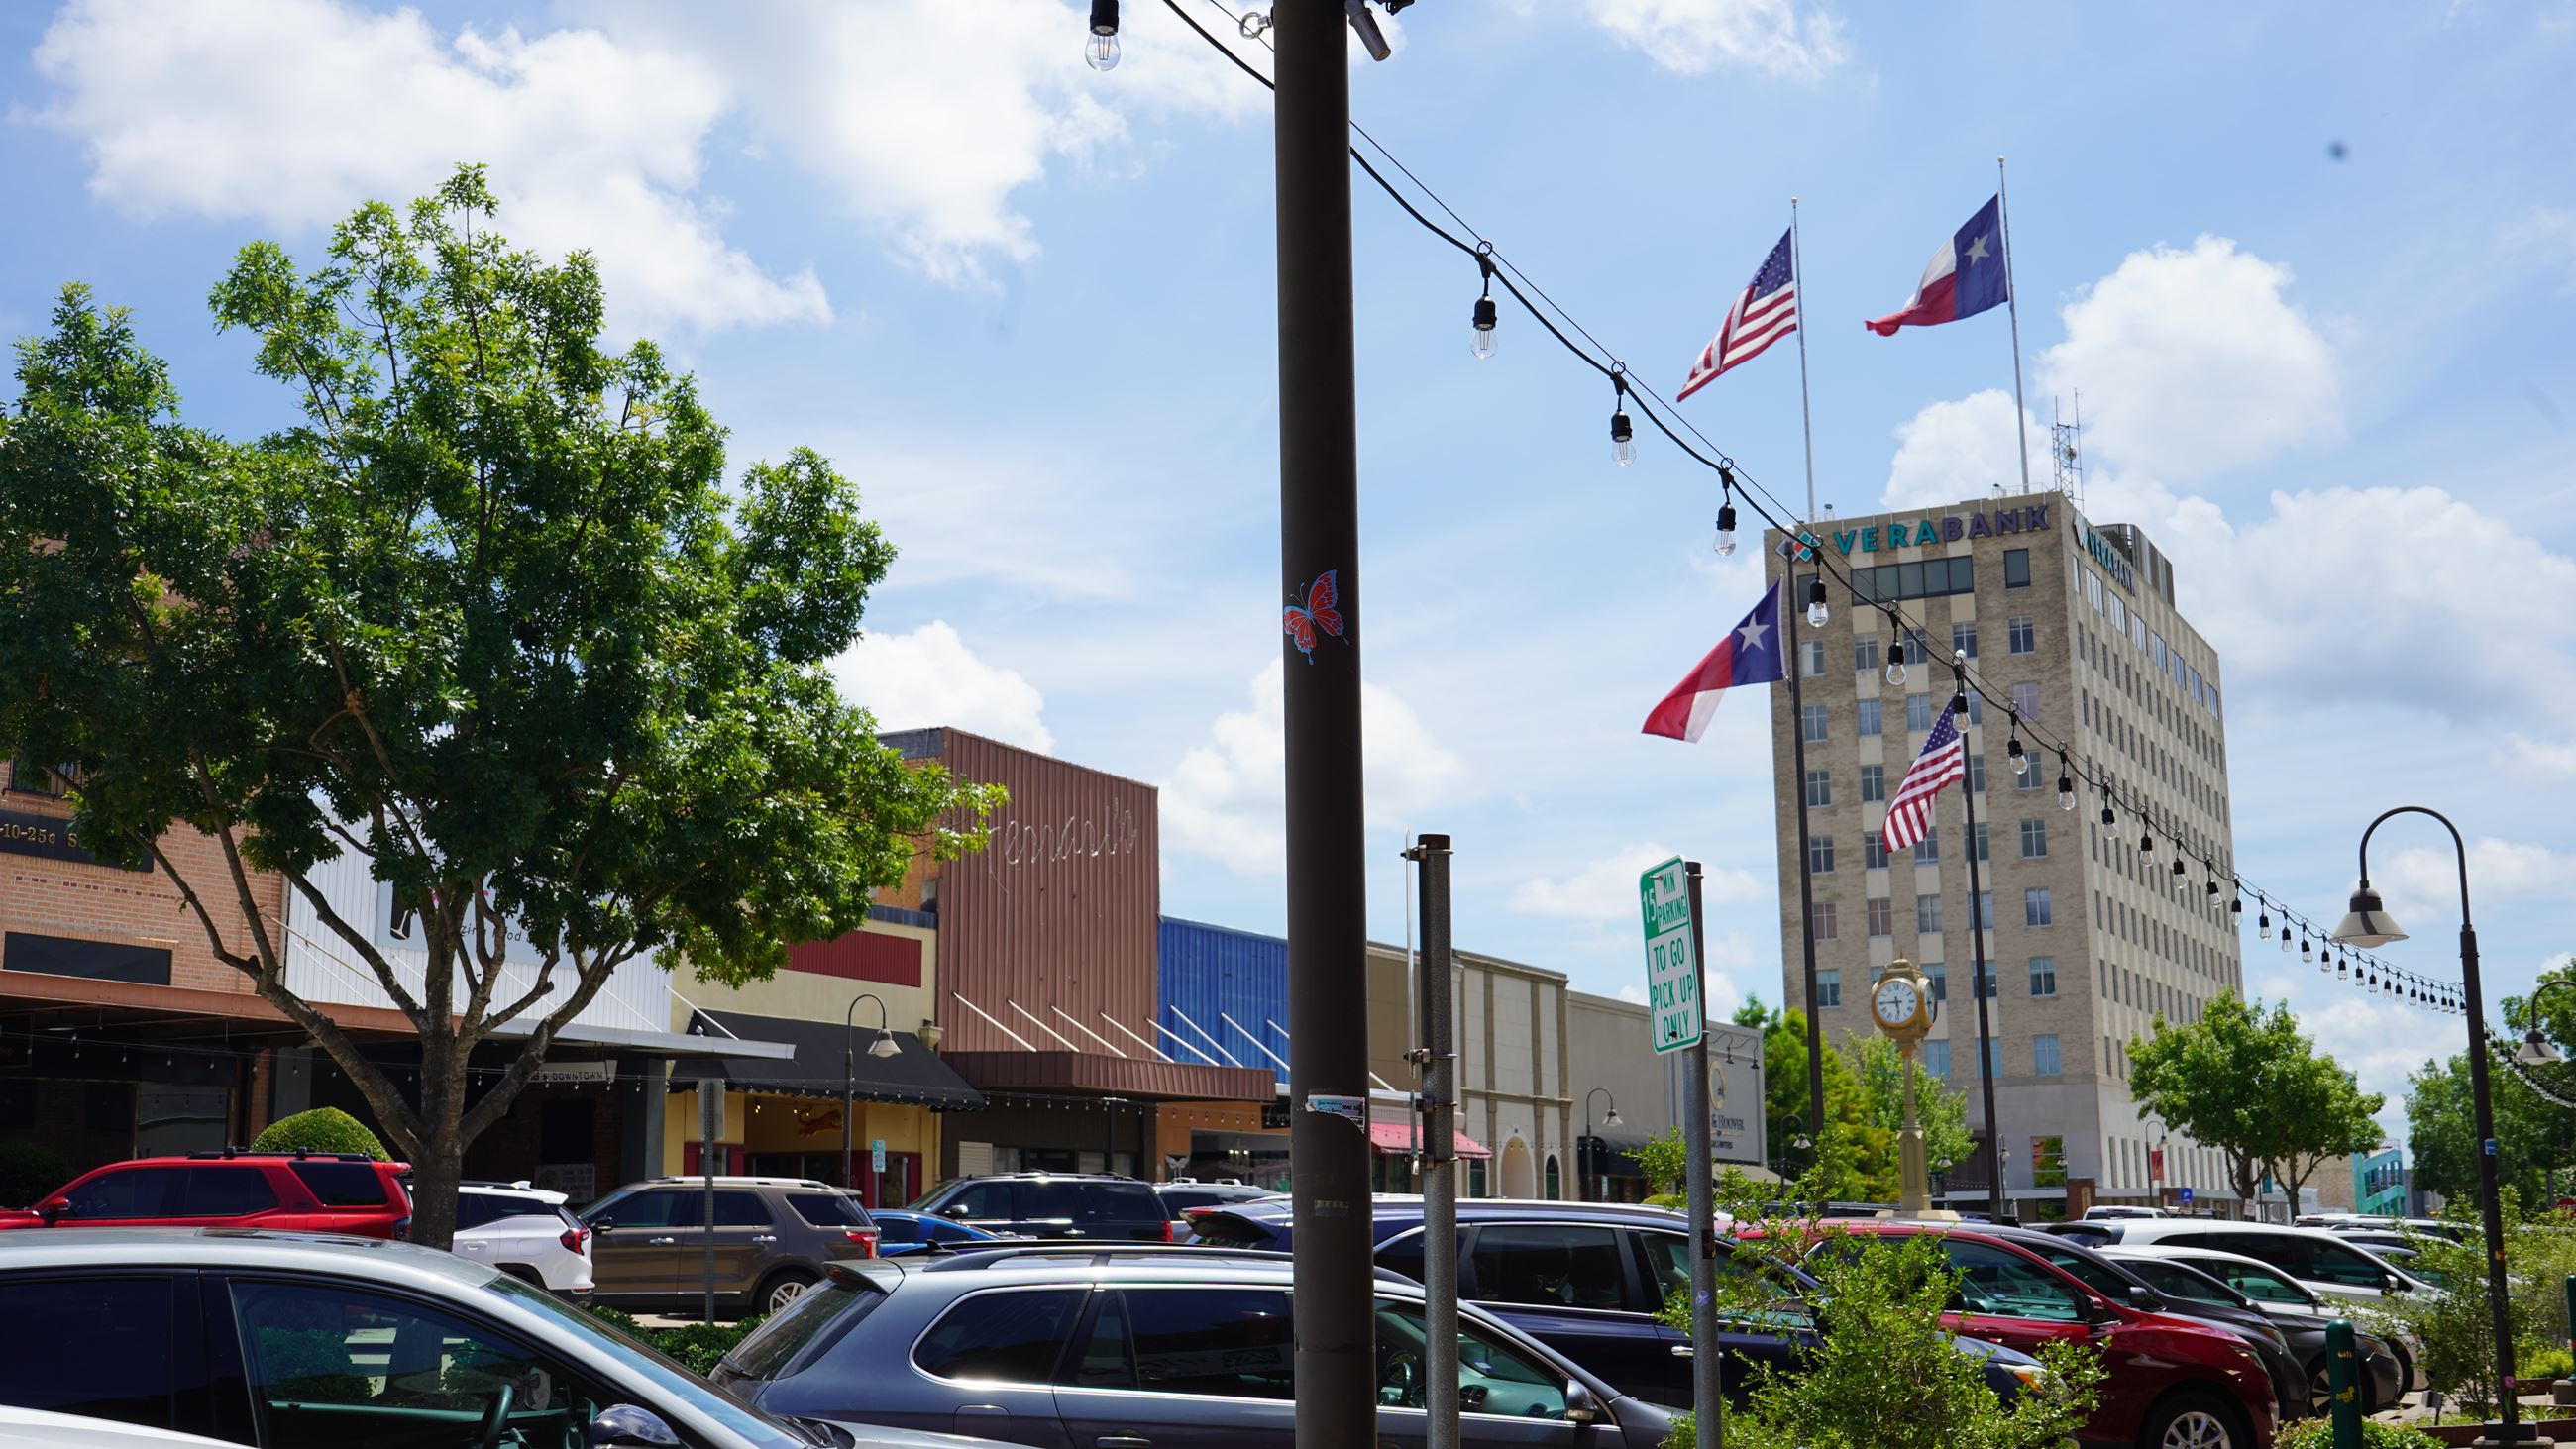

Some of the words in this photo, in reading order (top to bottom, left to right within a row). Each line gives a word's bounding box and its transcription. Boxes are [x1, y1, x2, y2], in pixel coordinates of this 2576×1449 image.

[1834, 504, 2050, 556] VERABANK
[1663, 871, 1676, 895] MIN
[1643, 887, 1657, 923] 15
[1658, 895, 1686, 928] PARKING
[1654, 944, 1666, 973] TO
[1670, 937, 1684, 967] GO
[1652, 980, 1675, 1012] PICK
[1679, 974, 1693, 1003] UP
[1664, 1010, 1689, 1043] ONLY
